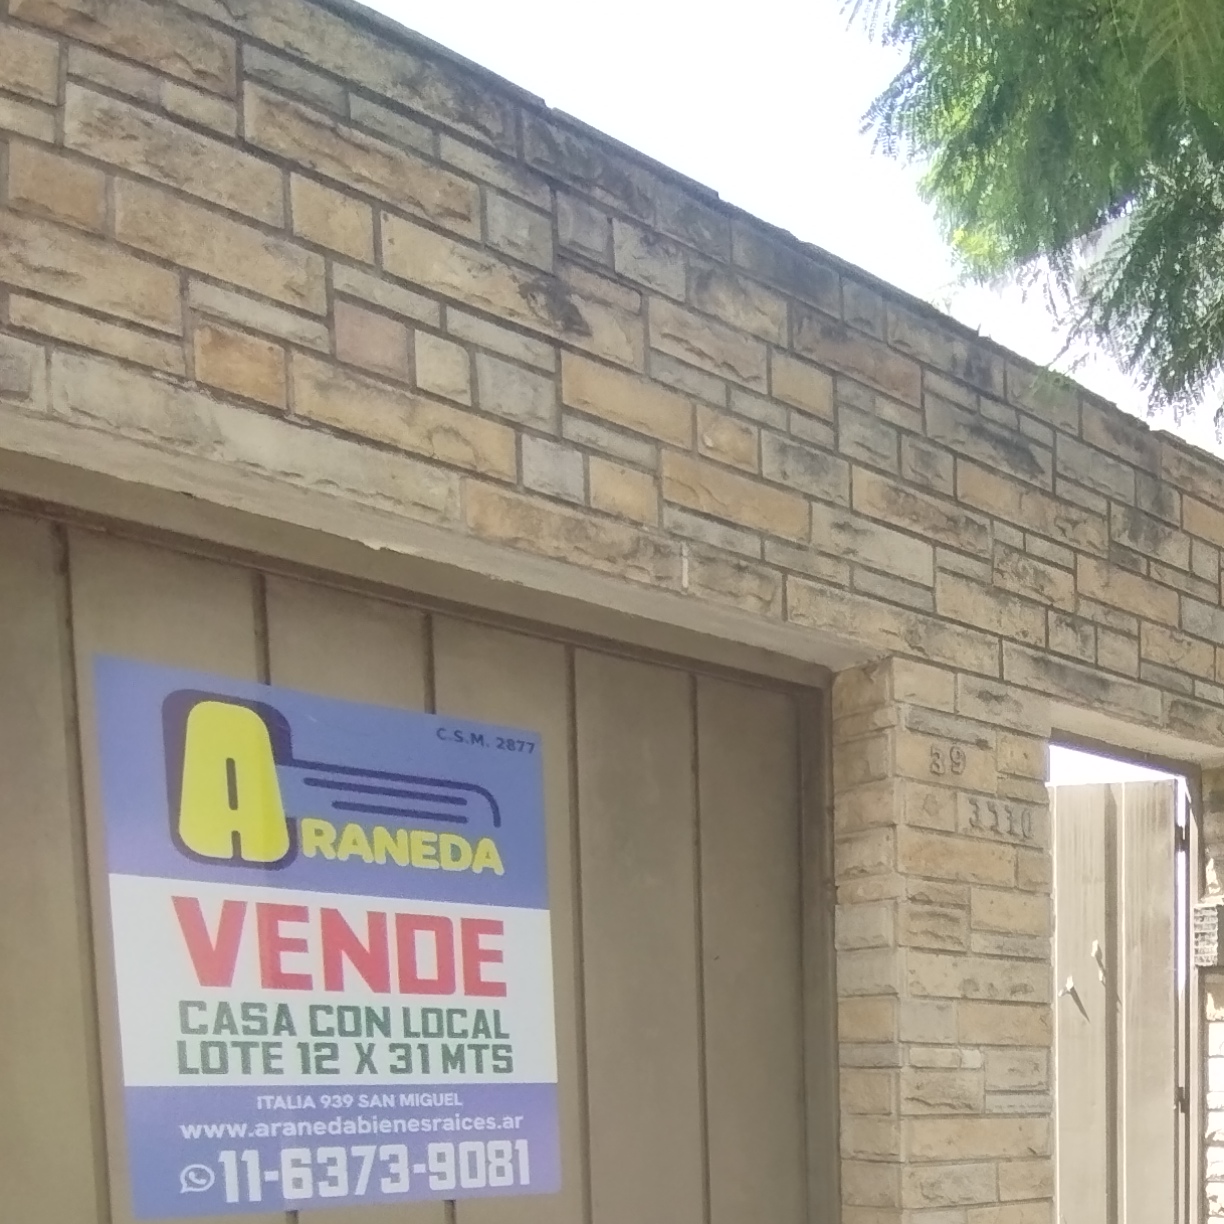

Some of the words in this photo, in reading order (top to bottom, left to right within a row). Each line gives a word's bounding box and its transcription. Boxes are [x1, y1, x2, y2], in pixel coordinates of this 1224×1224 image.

[496, 736, 536, 754] 2877
[171, 895, 507, 997] VENDE
[178, 1000, 297, 1036] CASA
[308, 1004, 392, 1039] CON
[402, 1006, 510, 1039] LOCAL
[176, 1040, 284, 1075] LOTE
[296, 1042, 340, 1075] 12
[355, 1043, 378, 1075] X
[389, 1043, 431, 1075] 31
[441, 1043, 514, 1075] MTS
[256, 1095, 316, 1110] ITALIA
[319, 1094, 353, 1109] 939
[358, 1094, 396, 1108] SAN
[399, 1092, 463, 1108] MIGUEL
[179, 1113, 524, 1140] www.aranedabienesraices.ar
[218, 1139, 530, 1203] 11-6373-9081
